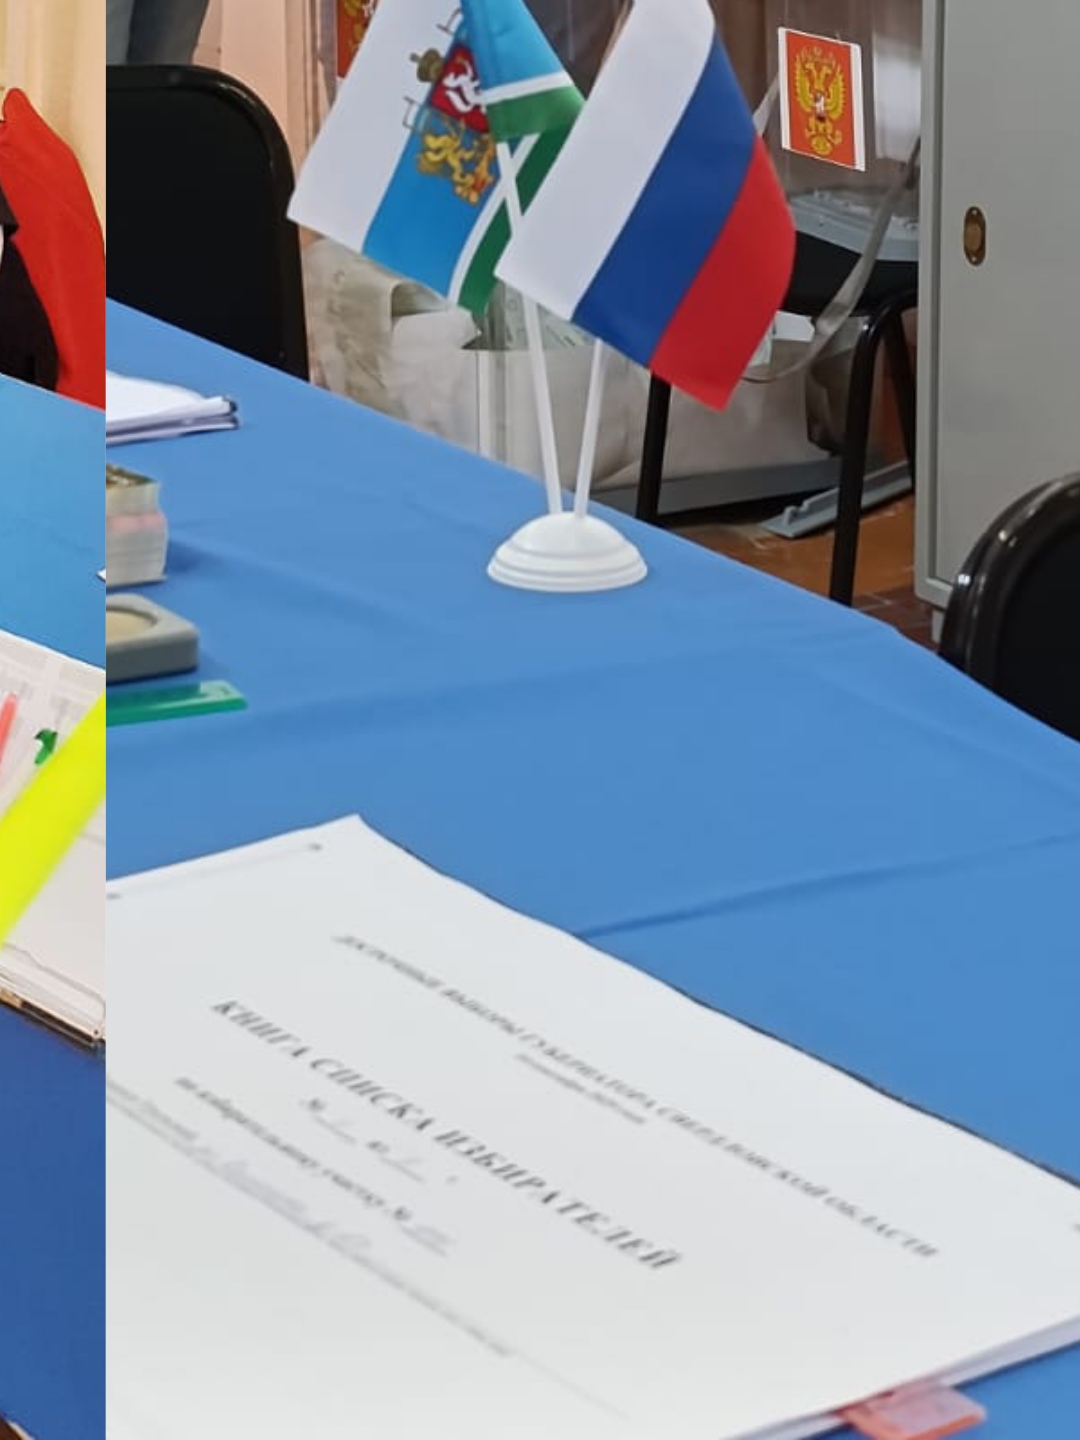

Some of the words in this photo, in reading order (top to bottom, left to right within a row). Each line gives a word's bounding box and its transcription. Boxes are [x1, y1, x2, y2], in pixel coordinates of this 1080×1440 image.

[210, 999, 312, 1058] КНИГА
[309, 1057, 436, 1131] СПИСКА
[433, 1128, 683, 1269] ИЗБИРАТЕЛЕЙ
